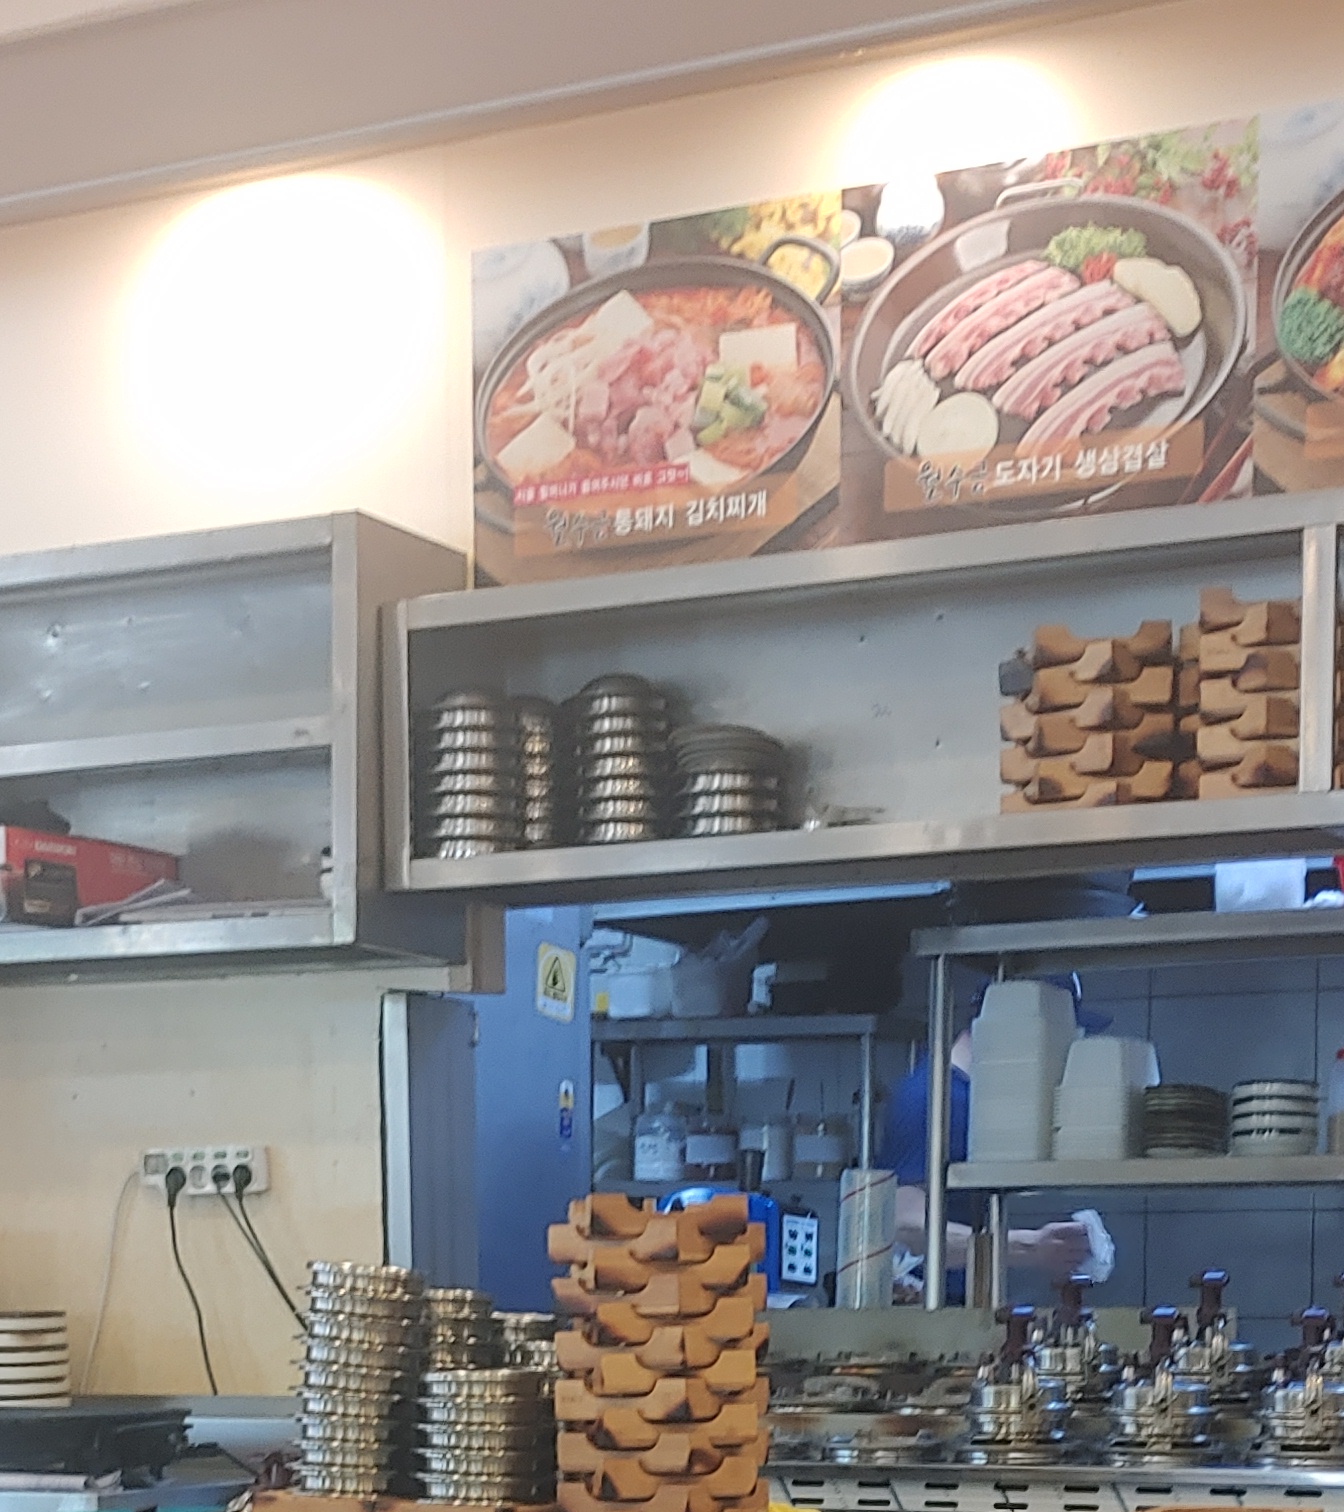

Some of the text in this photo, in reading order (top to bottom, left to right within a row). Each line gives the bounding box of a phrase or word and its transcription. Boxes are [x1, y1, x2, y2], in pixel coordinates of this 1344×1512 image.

[994, 455, 1062, 487] 도자기
[1074, 439, 1169, 480] 생삼겹살
[613, 503, 675, 536] 통돼지
[686, 489, 768, 526] 김치찌개
